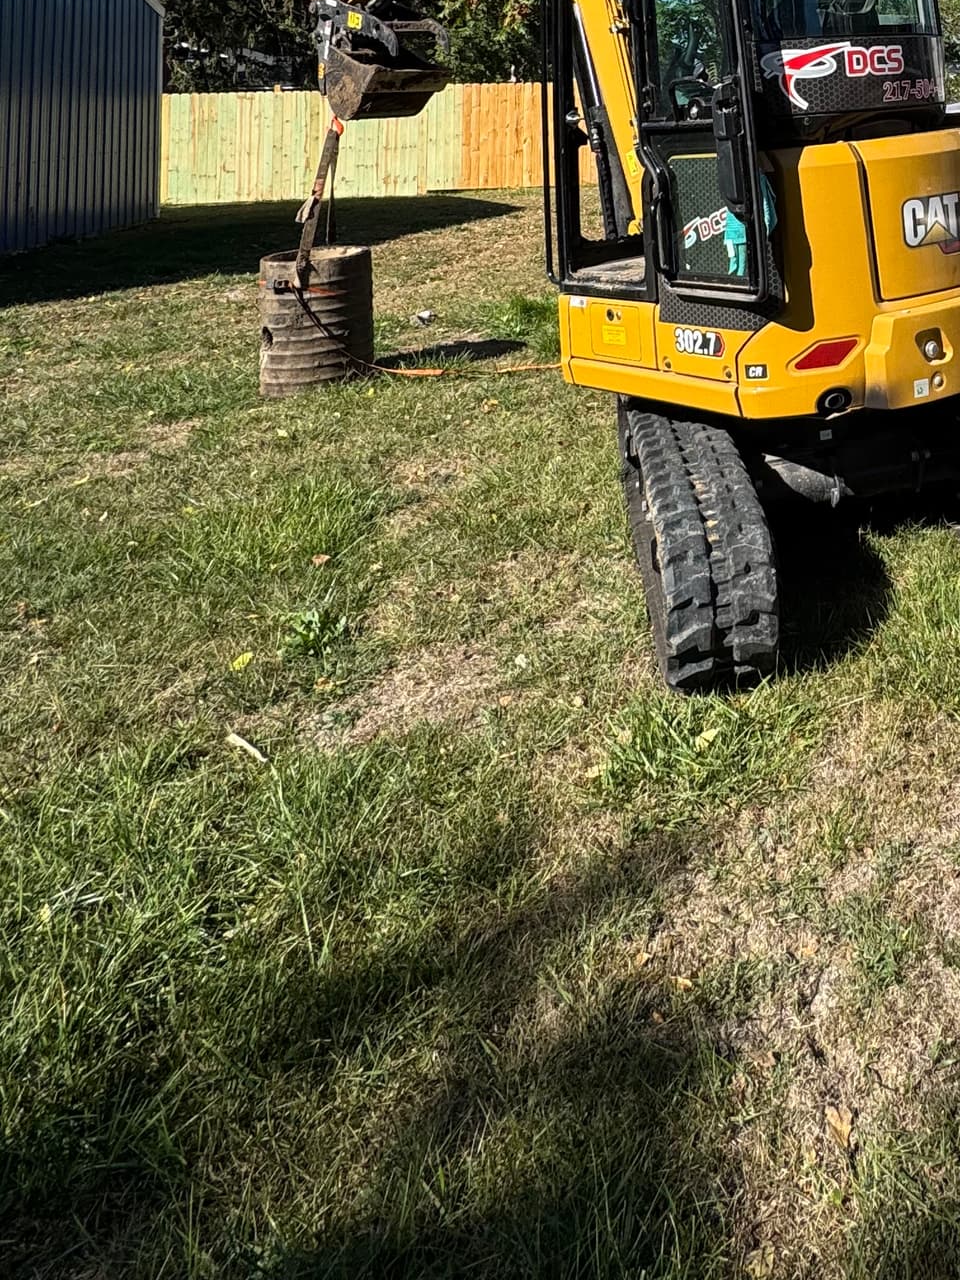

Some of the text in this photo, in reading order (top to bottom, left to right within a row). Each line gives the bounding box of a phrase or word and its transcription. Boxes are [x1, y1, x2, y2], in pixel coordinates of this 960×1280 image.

[846, 46, 904, 76] DCS
[903, 193, 959, 246] CAT
[675, 327, 716, 355] 302.7
[748, 366, 763, 377] CR
